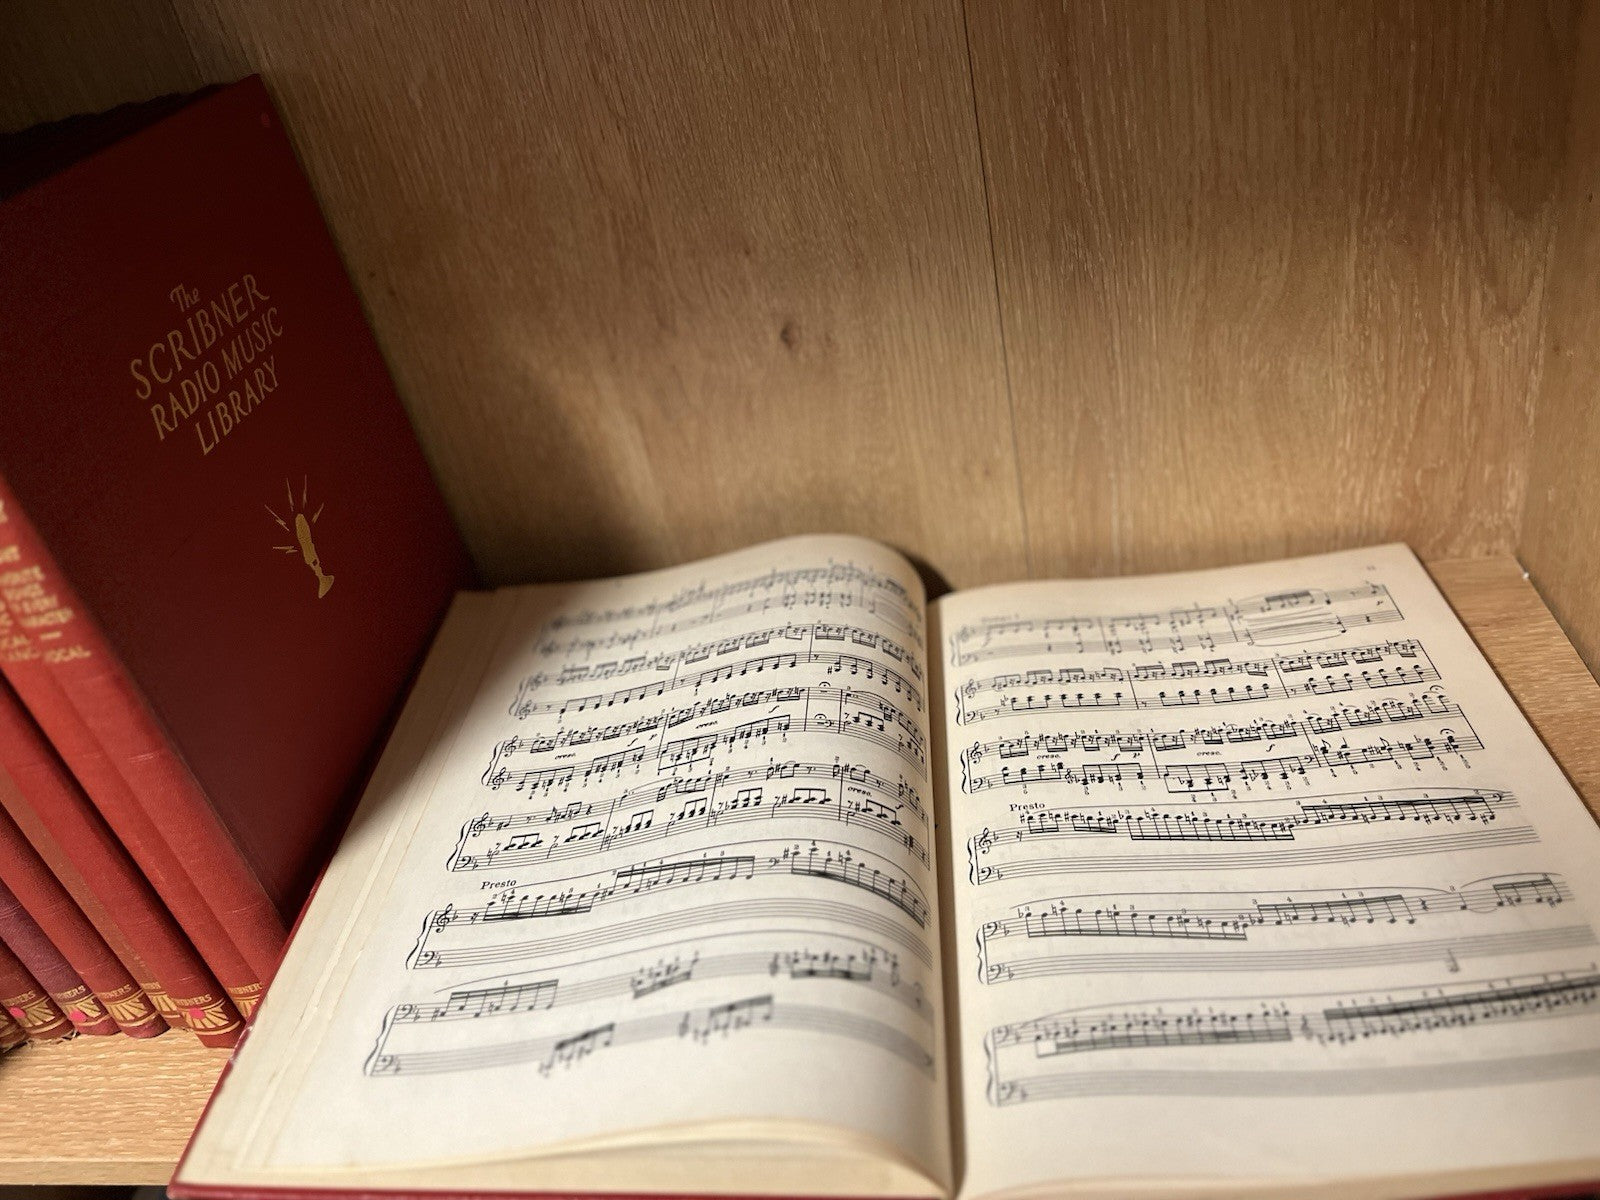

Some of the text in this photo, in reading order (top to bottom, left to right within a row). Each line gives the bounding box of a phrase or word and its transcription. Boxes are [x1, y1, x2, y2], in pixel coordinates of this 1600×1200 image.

[170, 283, 200, 312] The
[130, 274, 270, 400] SCRIBNER
[150, 306, 283, 441] RADIO MUSIC
[195, 355, 279, 456] LIBRARY
[1009, 802, 1046, 812] Presto
[480, 879, 517, 890] Presto
